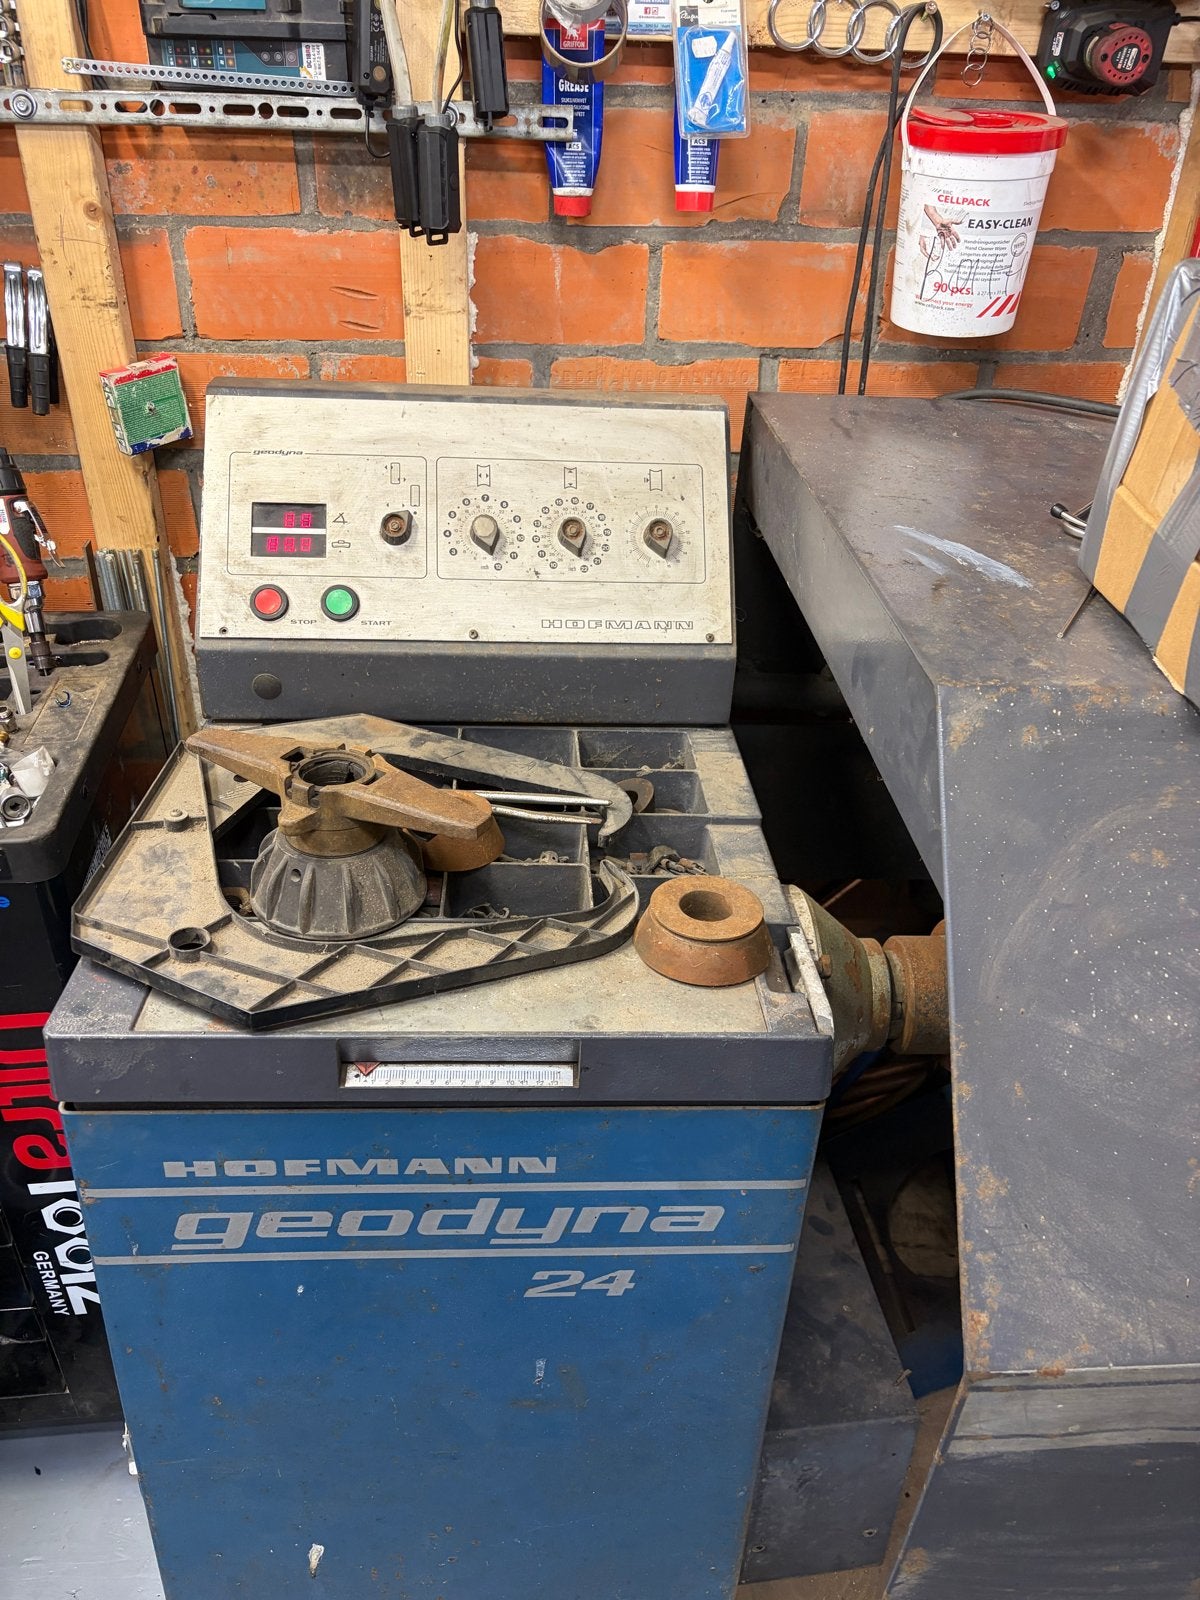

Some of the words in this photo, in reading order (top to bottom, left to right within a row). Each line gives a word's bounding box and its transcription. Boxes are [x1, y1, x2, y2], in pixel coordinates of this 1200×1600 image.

[938, 194, 991, 207] CELLPACK
[968, 217, 1033, 229] EASY-CLEAN
[933, 282, 948, 292] 90
[542, 619, 693, 630] HOFMANN
[163, 1156, 556, 1178] HOFMANN
[172, 1198, 725, 1250] geodyna
[32, 1250, 70, 1316] GERMANY
[524, 1269, 635, 1298] 24
